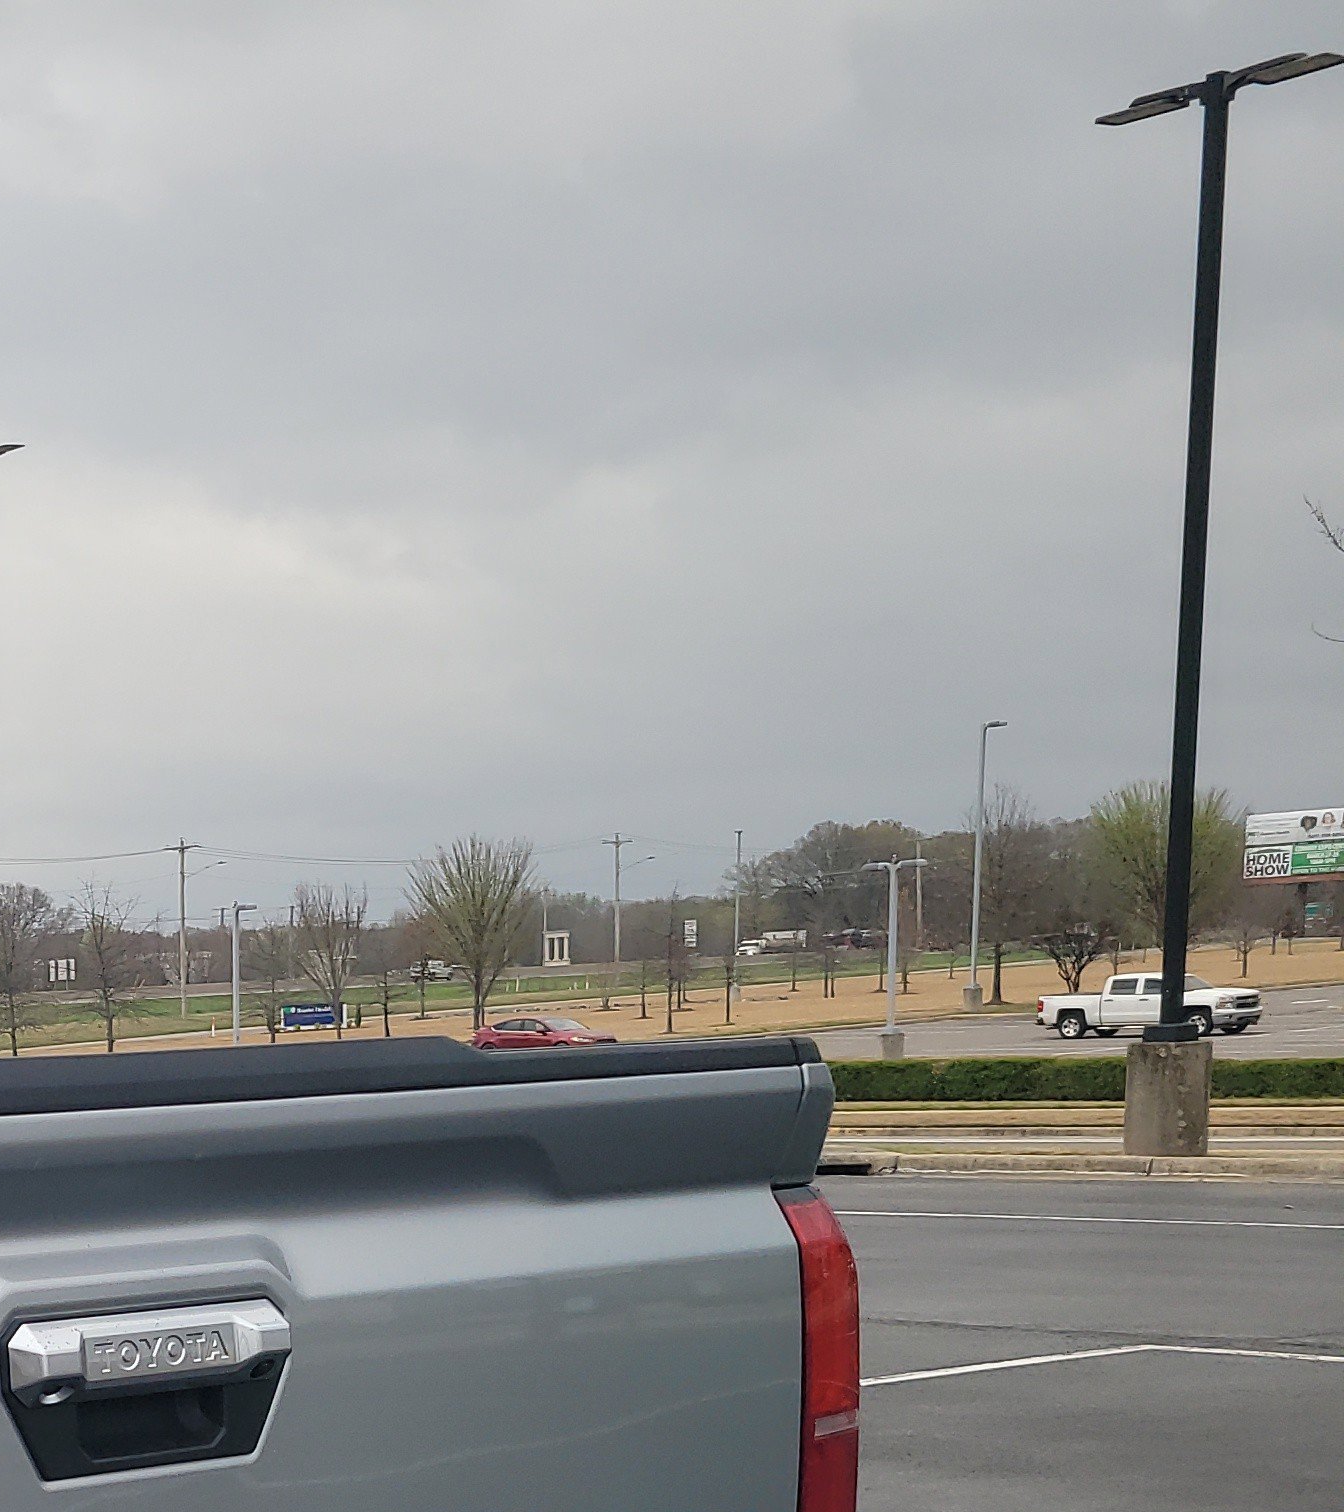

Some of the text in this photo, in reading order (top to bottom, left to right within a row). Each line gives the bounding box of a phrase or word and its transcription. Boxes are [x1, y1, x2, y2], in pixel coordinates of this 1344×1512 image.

[1245, 853, 1290, 866] HOME
[1245, 864, 1290, 877] SHOW
[93, 1330, 230, 1374] TOYOTA
